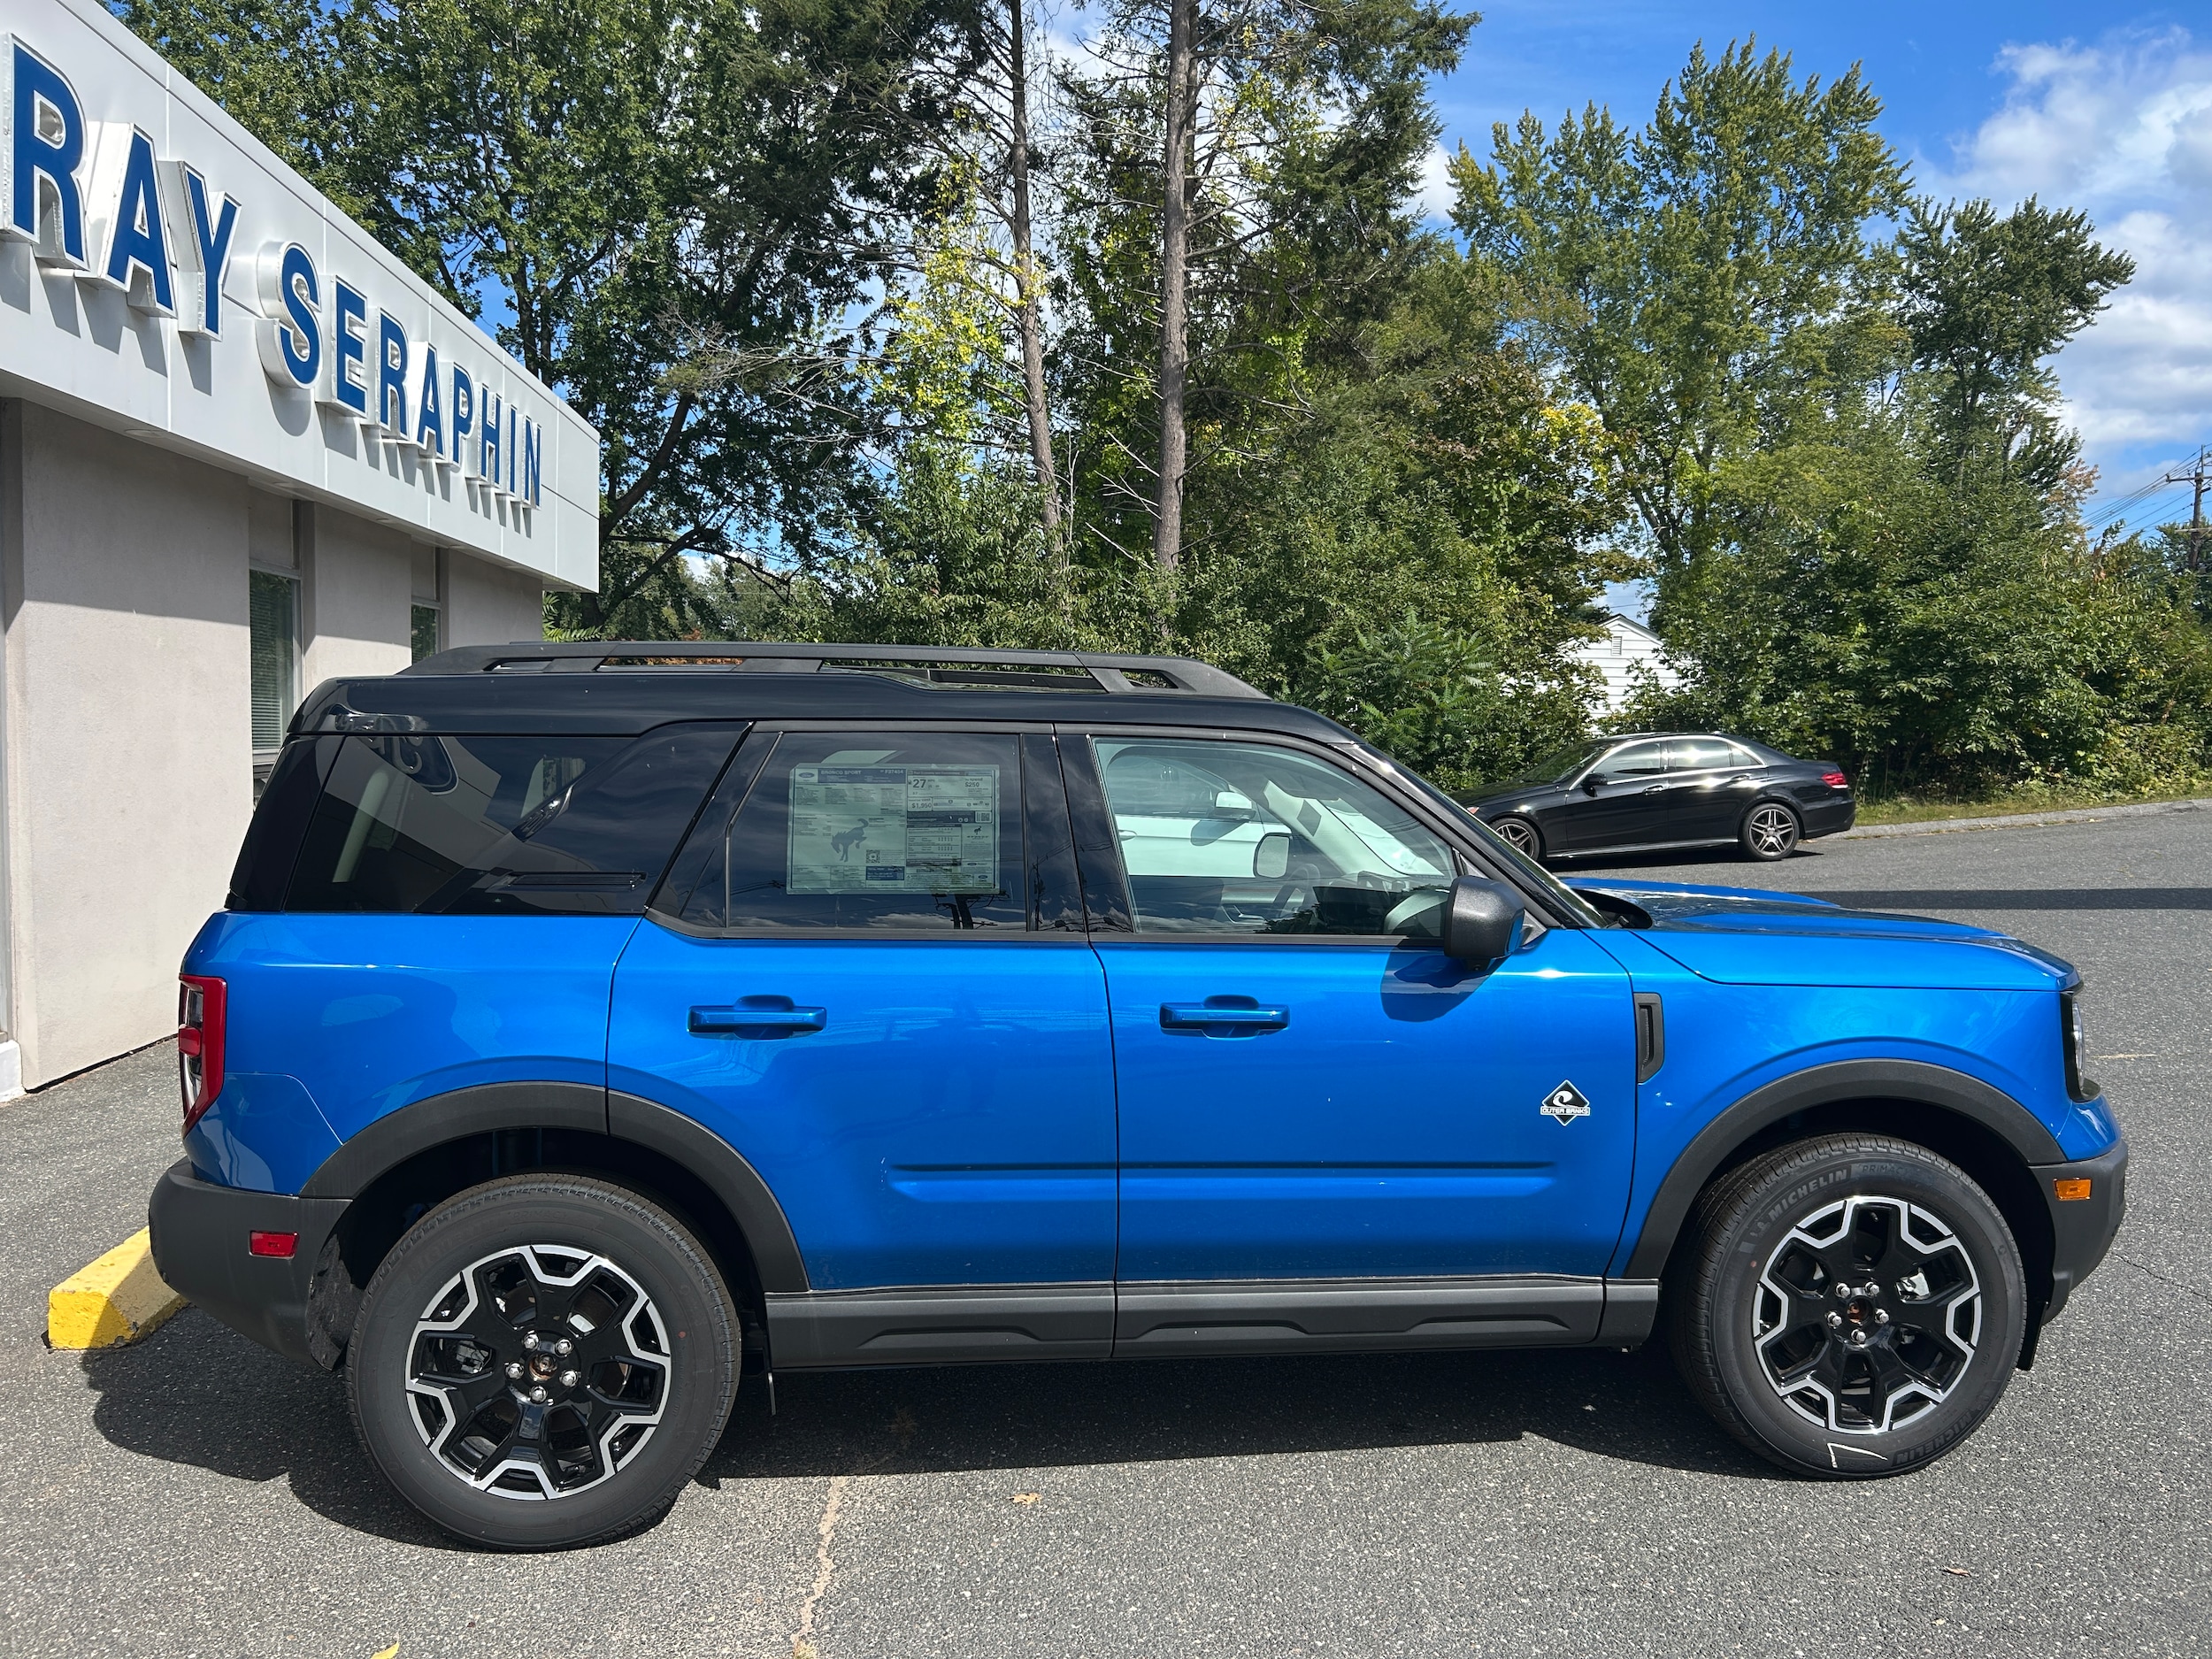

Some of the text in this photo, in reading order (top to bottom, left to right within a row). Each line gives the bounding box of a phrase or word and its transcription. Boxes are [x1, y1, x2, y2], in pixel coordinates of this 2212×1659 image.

[4, 33, 541, 510] RAY SERAPHIN
[912, 780, 926, 788] 27
[1769, 1169, 1847, 1221] MICHELIN
[1896, 1414, 1971, 1464] MICHELIN
